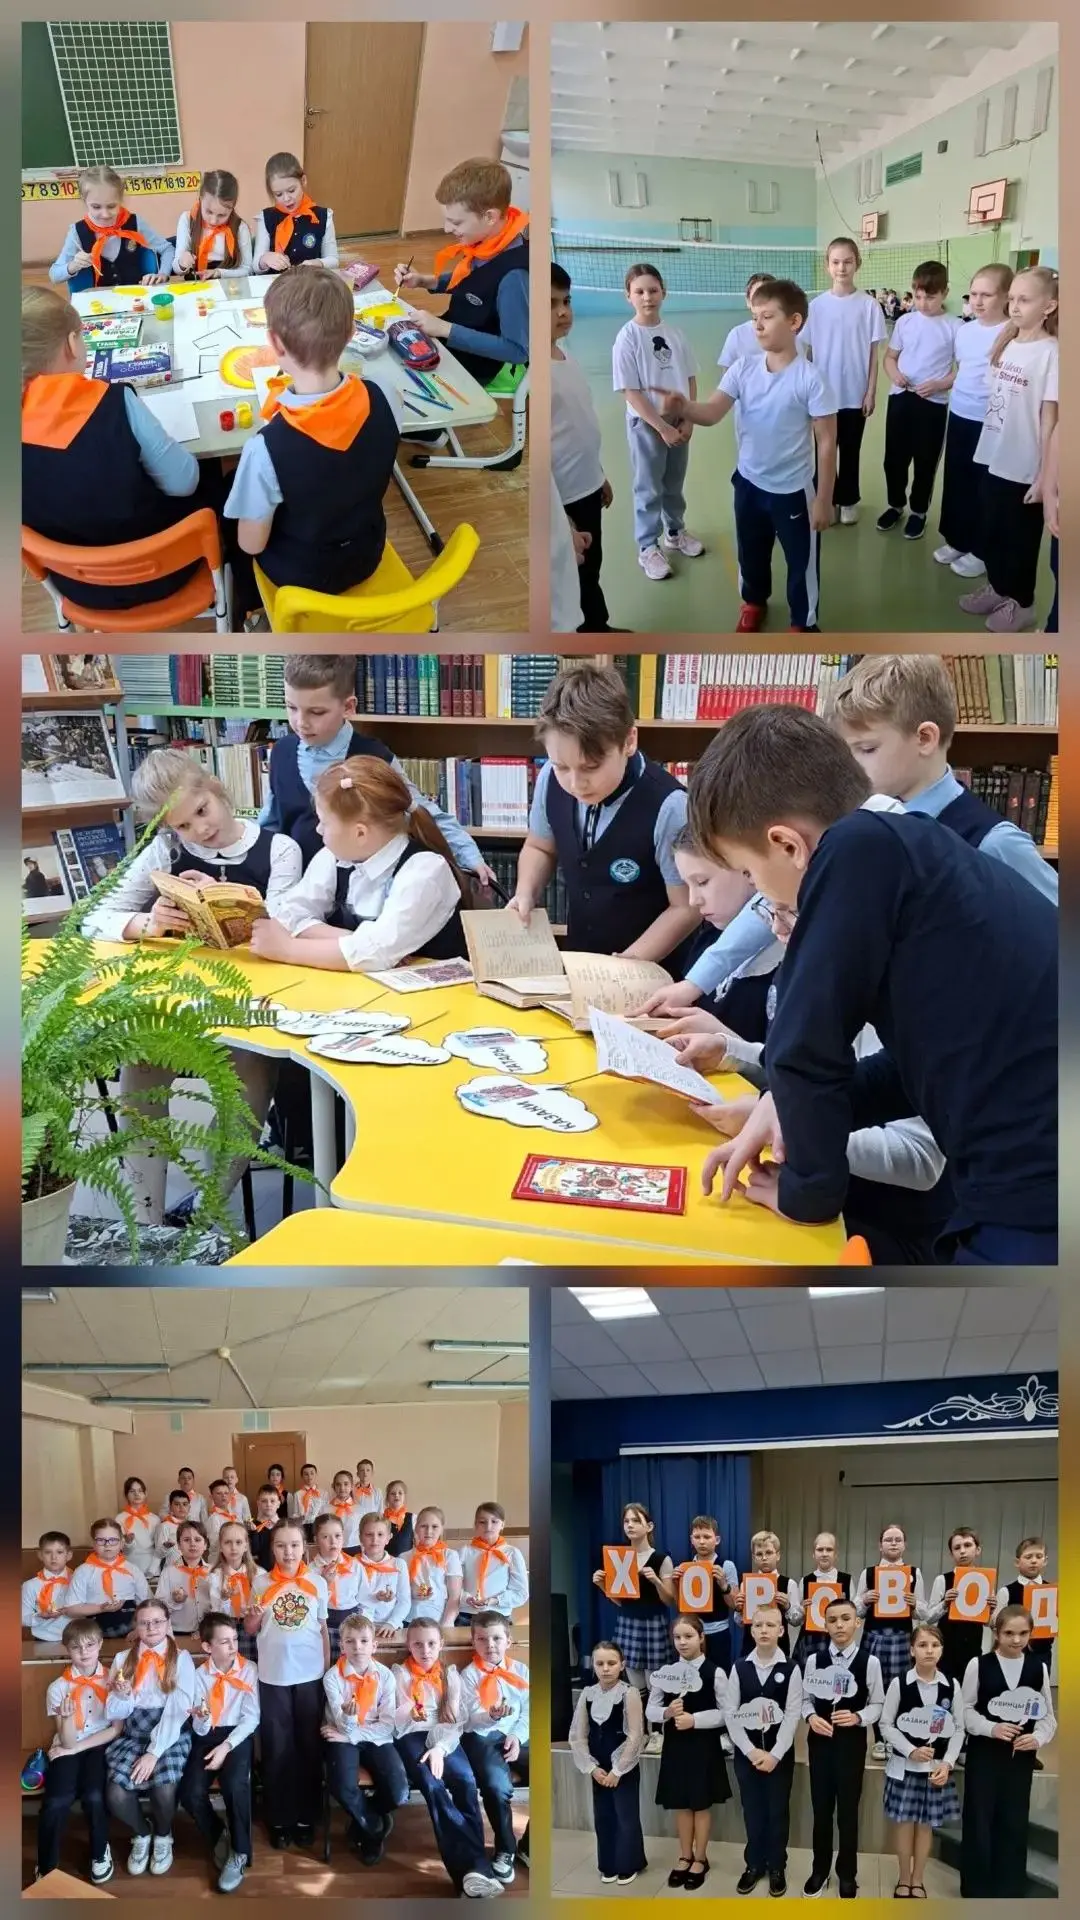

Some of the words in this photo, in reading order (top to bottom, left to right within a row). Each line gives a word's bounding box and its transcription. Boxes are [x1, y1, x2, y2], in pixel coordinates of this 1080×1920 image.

[27, 183, 34, 196] 7
[39, 183, 48, 196] 8
[50, 182, 59, 196] 9
[61, 182, 75, 196] 10
[130, 180, 140, 191] 15
[142, 179, 151, 191] 16
[153, 178, 162, 189] 17
[164, 177, 174, 189] 18
[175, 176, 185, 188] 19
[187, 175, 197, 187] 20
[999, 371, 1029, 387] Stories
[365, 1046, 439, 1063] РУССКИЕ
[489, 1046, 523, 1072] ТАТАРЫ
[516, 1100, 576, 1130] КАЗАКИ
[607, 1549, 637, 1595] Х
[682, 1565, 711, 1608] О
[745, 1576, 776, 1620] Р
[878, 1570, 908, 1615] В
[955, 1571, 990, 1617] О
[1031, 1587, 1058, 1633] Д
[806, 1677, 832, 1685] ТАТАРЫ
[991, 1700, 1024, 1709] ТУВИНЦЫ
[901, 1716, 928, 1724] КАЗАКИ
